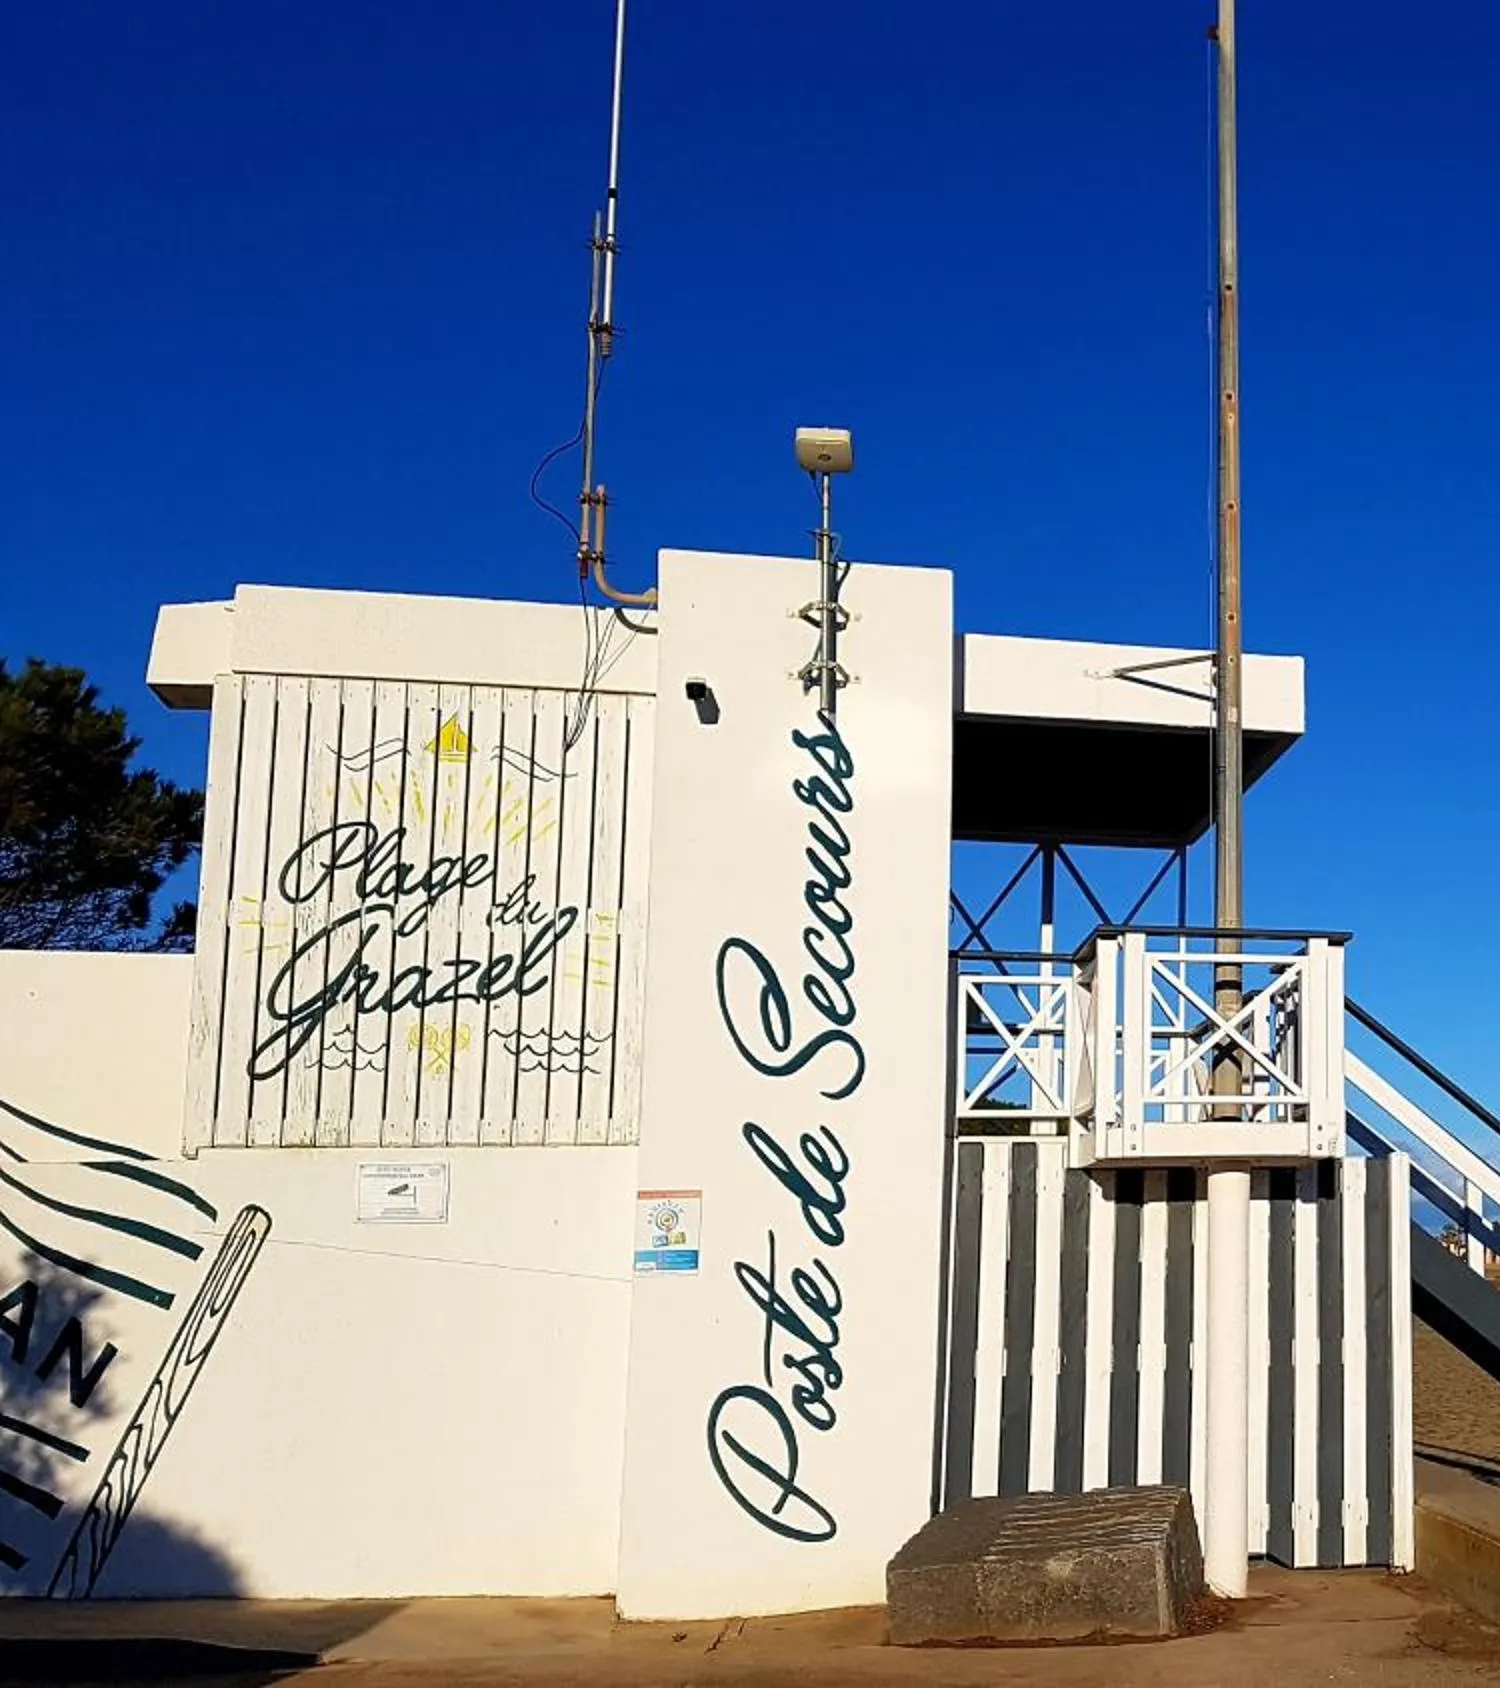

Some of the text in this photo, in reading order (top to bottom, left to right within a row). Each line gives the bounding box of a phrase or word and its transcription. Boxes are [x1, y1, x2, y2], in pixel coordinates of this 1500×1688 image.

[279, 821, 548, 937] Plage du
[247, 904, 578, 1080] Grazel
[707, 709, 866, 1543] Poste de Secours
